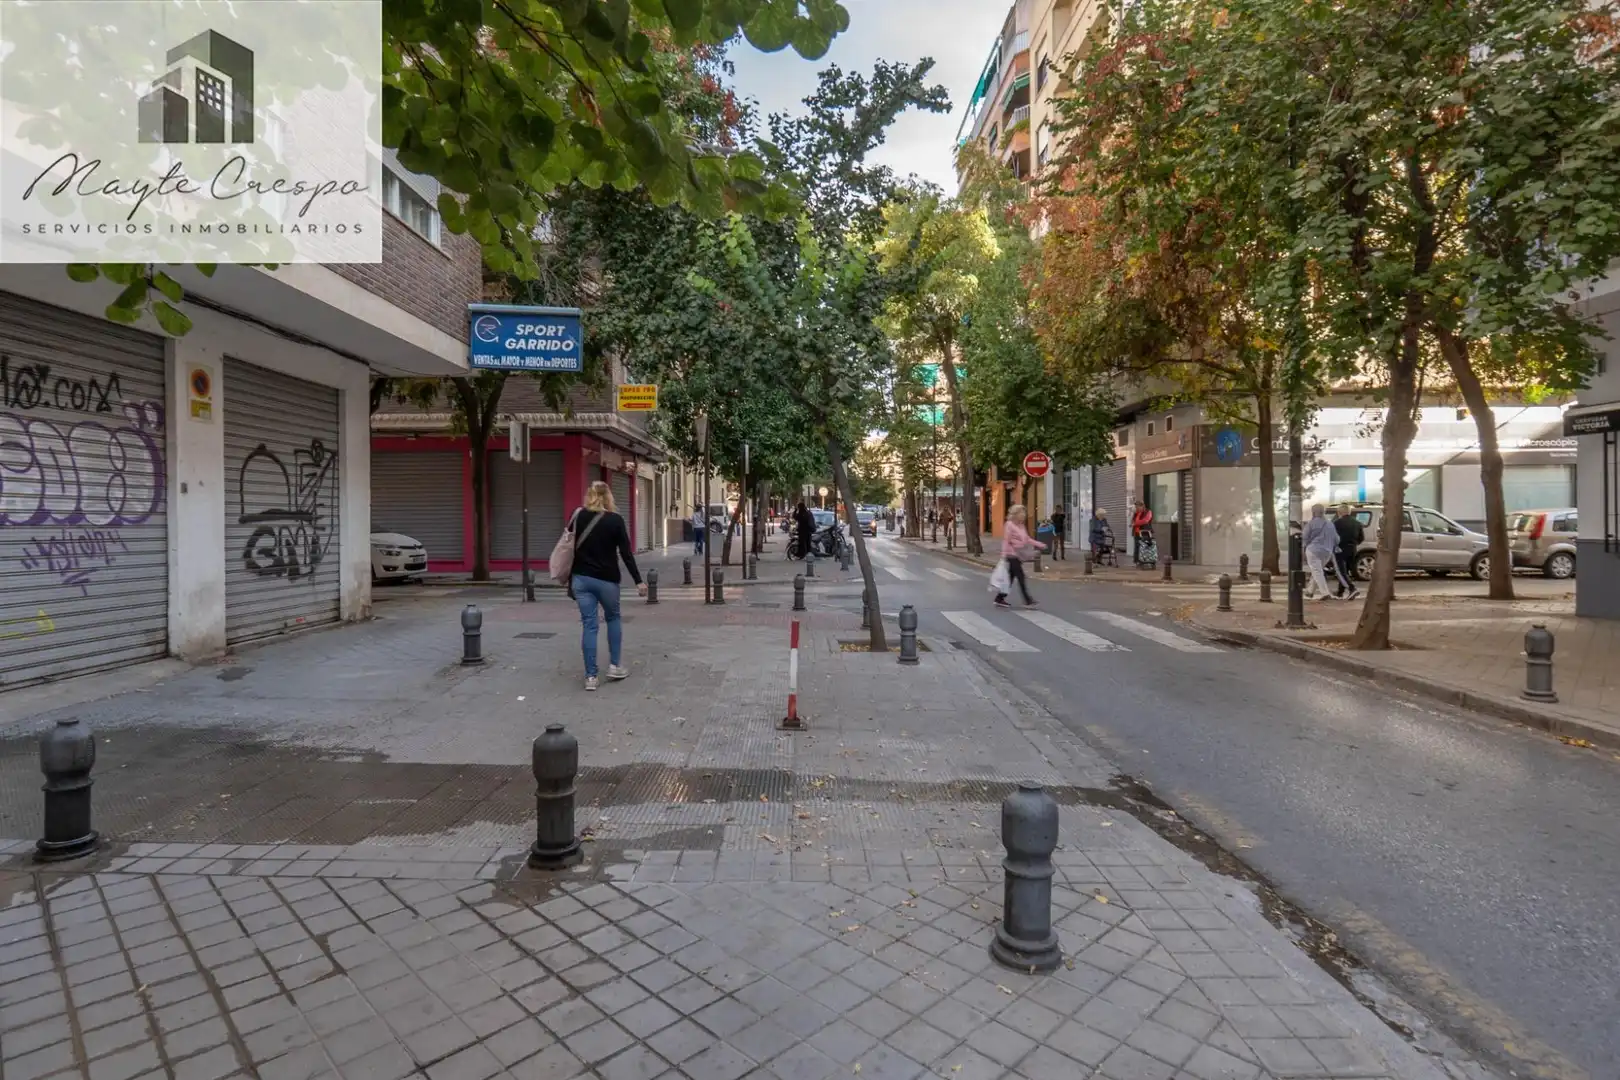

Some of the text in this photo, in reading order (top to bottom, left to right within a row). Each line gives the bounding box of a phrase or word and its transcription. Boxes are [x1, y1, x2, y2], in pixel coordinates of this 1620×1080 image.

[516, 324, 566, 337] SPORT
[505, 338, 574, 352] GARRIDO
[474, 354, 494, 366] VENTAS
[501, 355, 520, 367] MAYOR
[525, 356, 544, 368] MENOR
[551, 357, 577, 369] DEPORTES
[1572, 421, 1610, 431] VICTORIA
